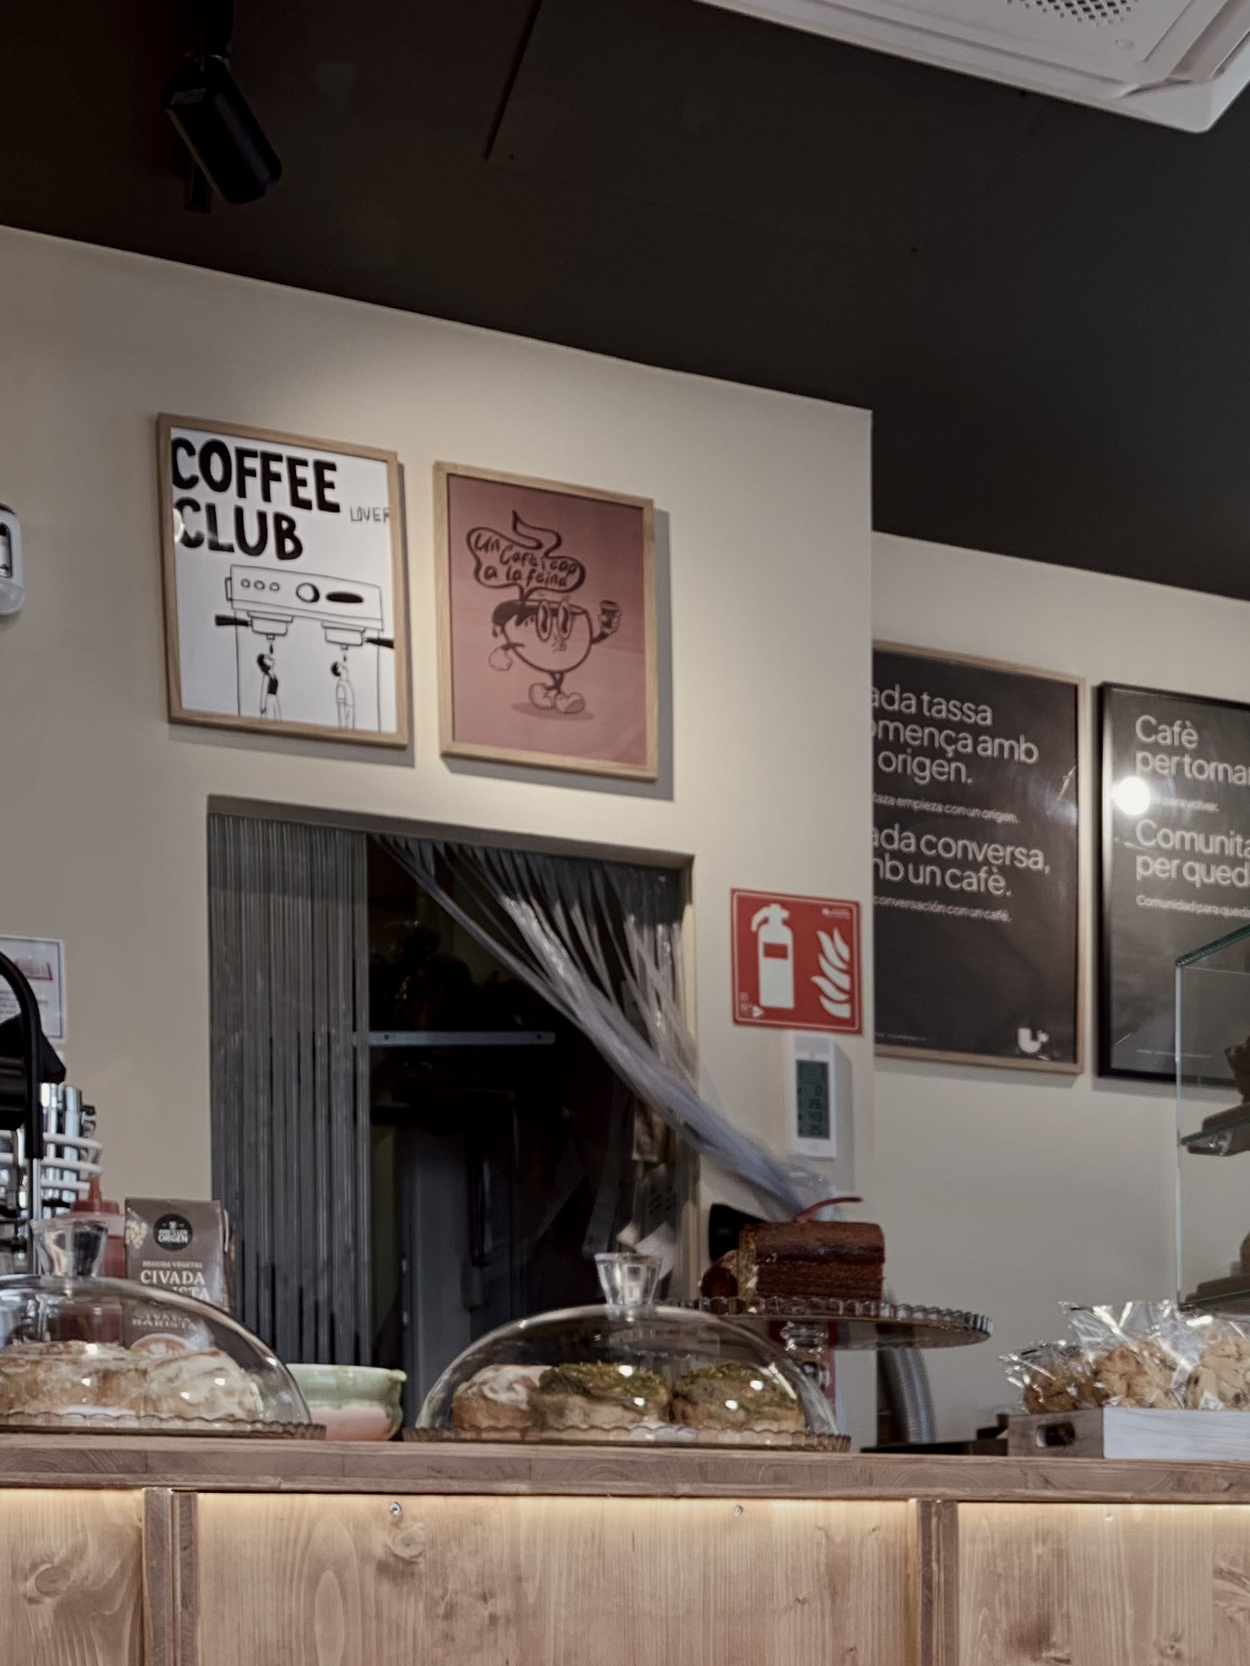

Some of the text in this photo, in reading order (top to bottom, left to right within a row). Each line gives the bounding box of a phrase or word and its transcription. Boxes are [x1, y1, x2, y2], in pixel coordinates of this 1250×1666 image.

[171, 437, 341, 513] COFFEE
[172, 497, 304, 560] CLUB
[474, 532, 500, 553] Un
[483, 565, 567, 587] a la feina
[920, 691, 993, 727] tassa
[1135, 714, 1199, 749] Cafè
[977, 734, 1040, 764] amb
[877, 748, 973, 785] origen.
[1135, 751, 1181, 777] per
[896, 797, 944, 813] empieza
[944, 803, 968, 816] con
[919, 834, 1051, 874] conversa,
[1135, 854, 1181, 881] per
[908, 862, 942, 887] un
[944, 865, 1012, 897] cafè.
[947, 905, 969, 917] con
[1135, 894, 1197, 912] Comunidad
[1197, 904, 1219, 915] para
[140, 1270, 205, 1286] CIVADA
